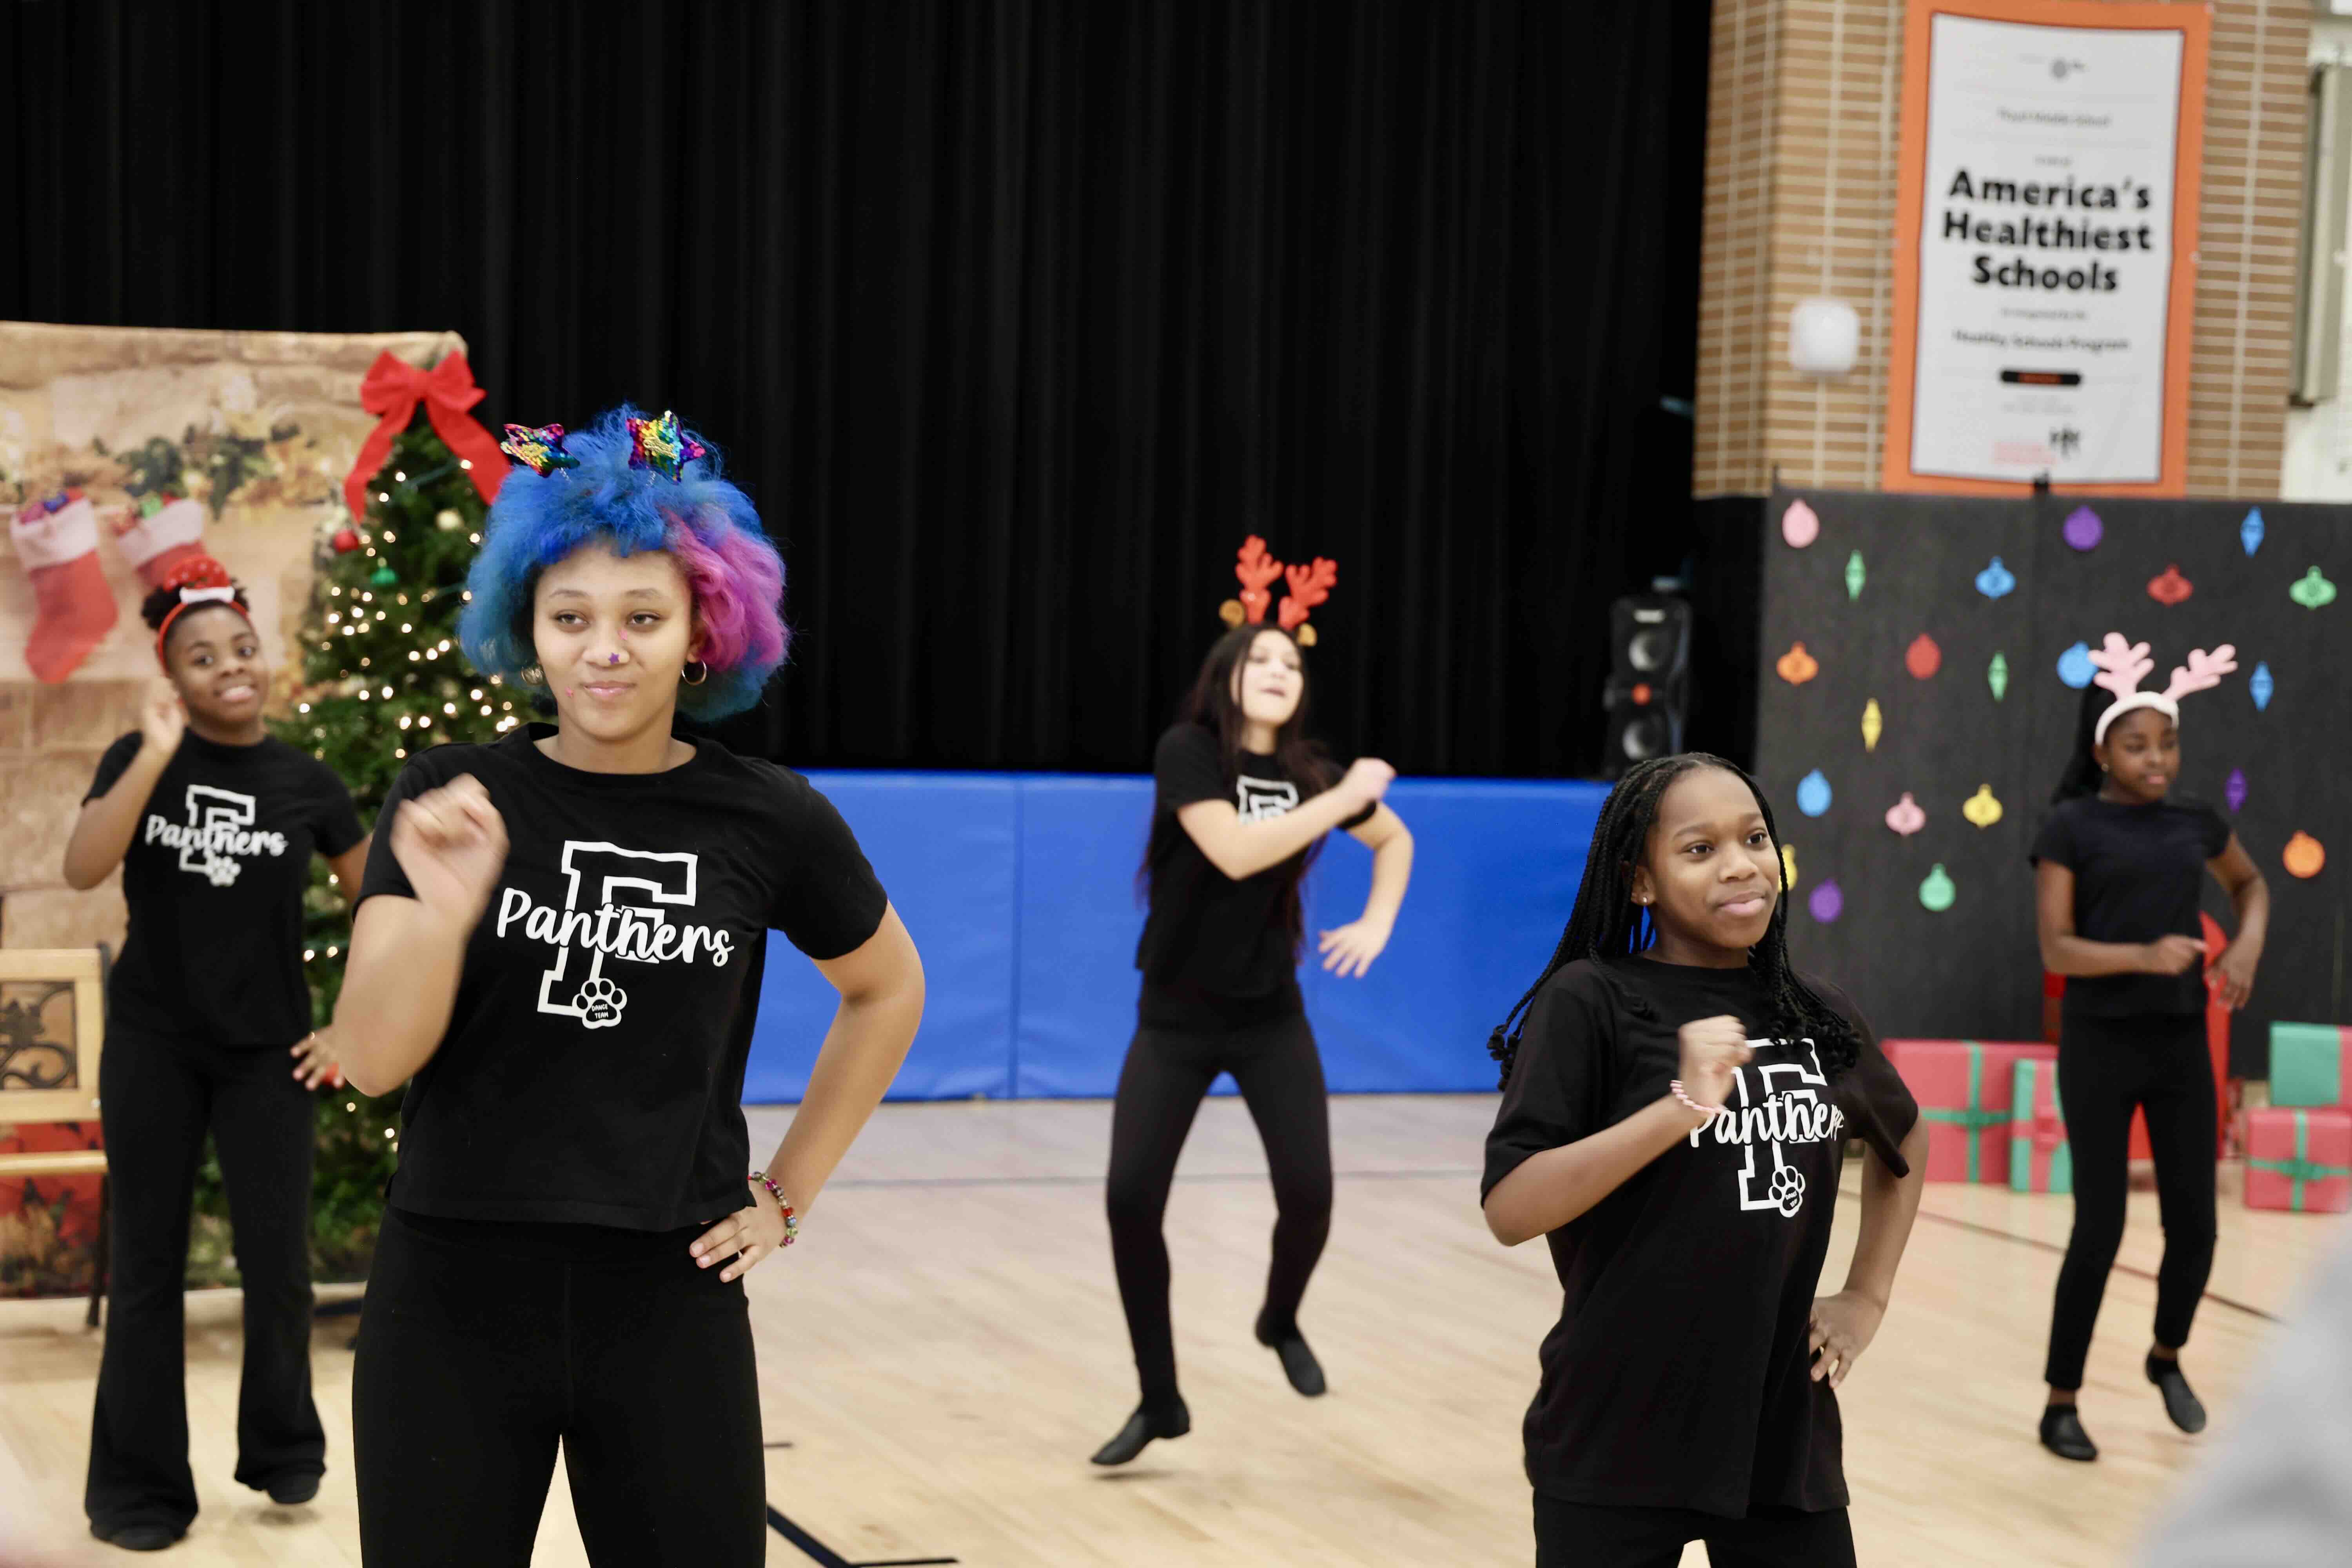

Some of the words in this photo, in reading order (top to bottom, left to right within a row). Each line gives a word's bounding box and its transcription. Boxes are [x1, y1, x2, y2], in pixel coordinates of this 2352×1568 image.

[1949, 169, 2150, 209] America's
[1943, 210, 2151, 251] Healthiest
[1973, 255, 2118, 291] Schools
[145, 814, 289, 857] Panthers
[497, 887, 735, 967] Panthers
[592, 1004, 608, 1012] DANCE
